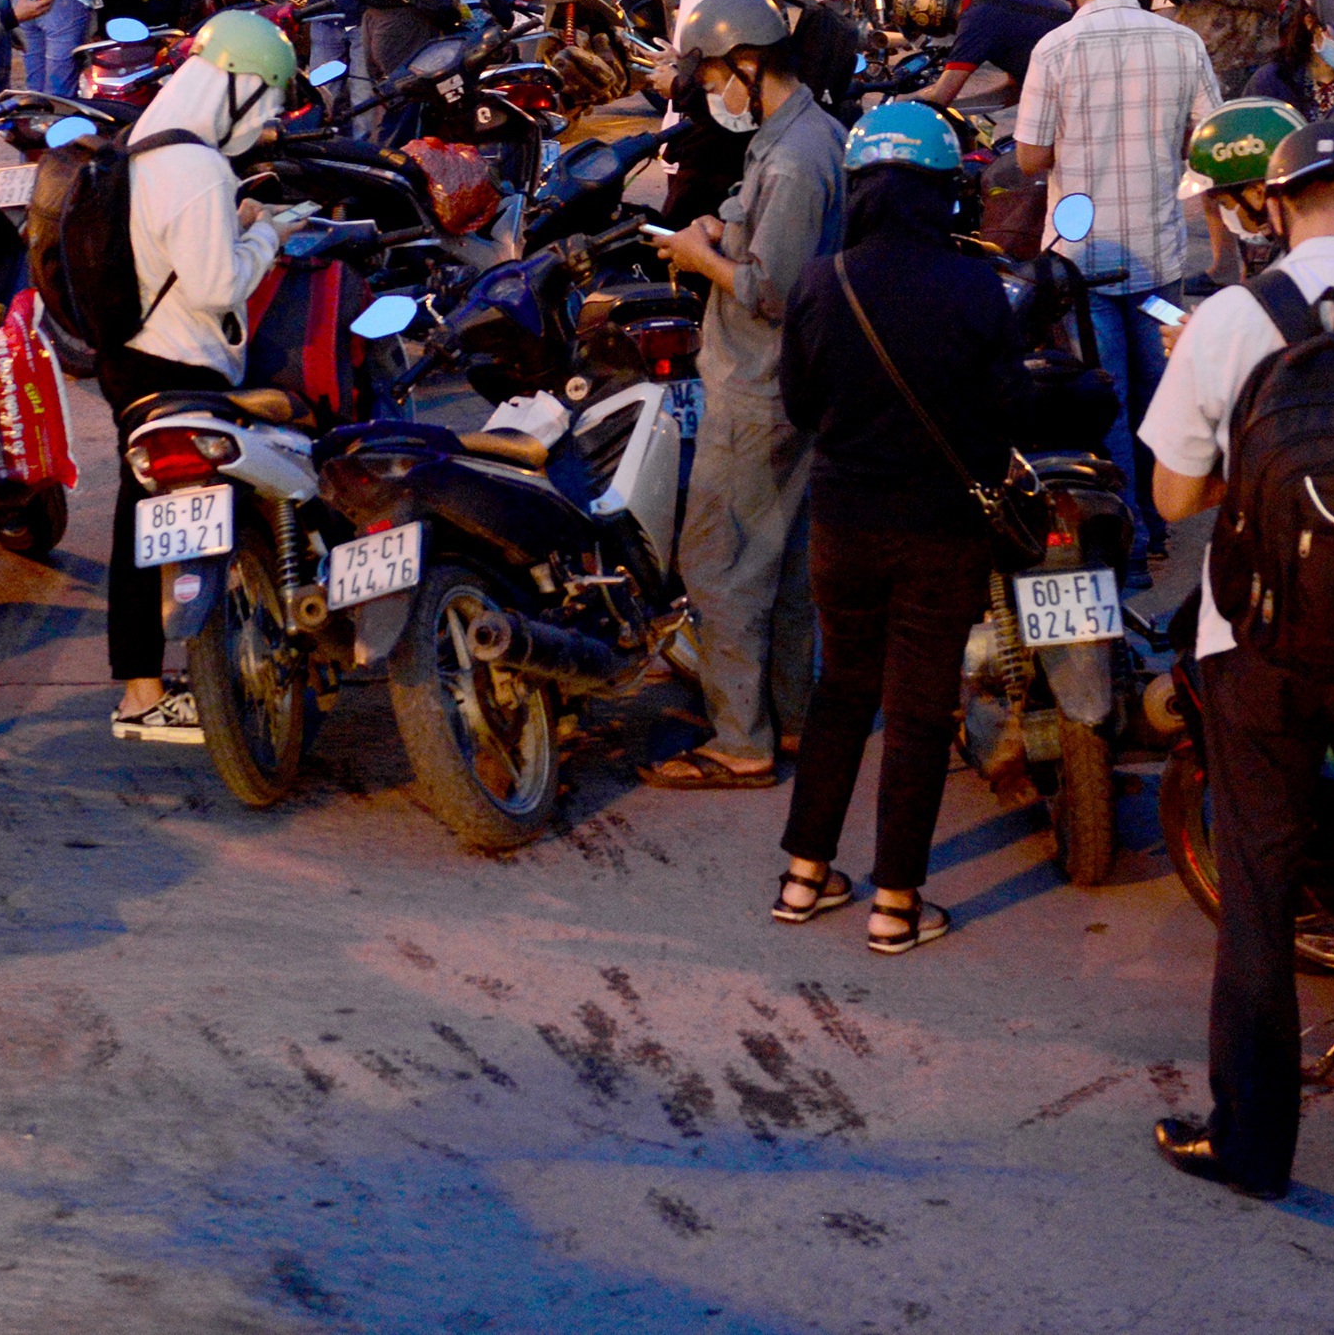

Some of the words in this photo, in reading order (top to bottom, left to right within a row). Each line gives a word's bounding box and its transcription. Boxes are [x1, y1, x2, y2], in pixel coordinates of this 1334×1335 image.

[1212, 134, 1265, 162] Grab
[152, 494, 215, 529] 86-B7
[143, 522, 224, 560] 393.21
[346, 532, 404, 571] 75-C1
[338, 558, 413, 602] 144.76
[1032, 574, 1101, 607] 60-F1
[1027, 605, 1115, 640] 824.57
